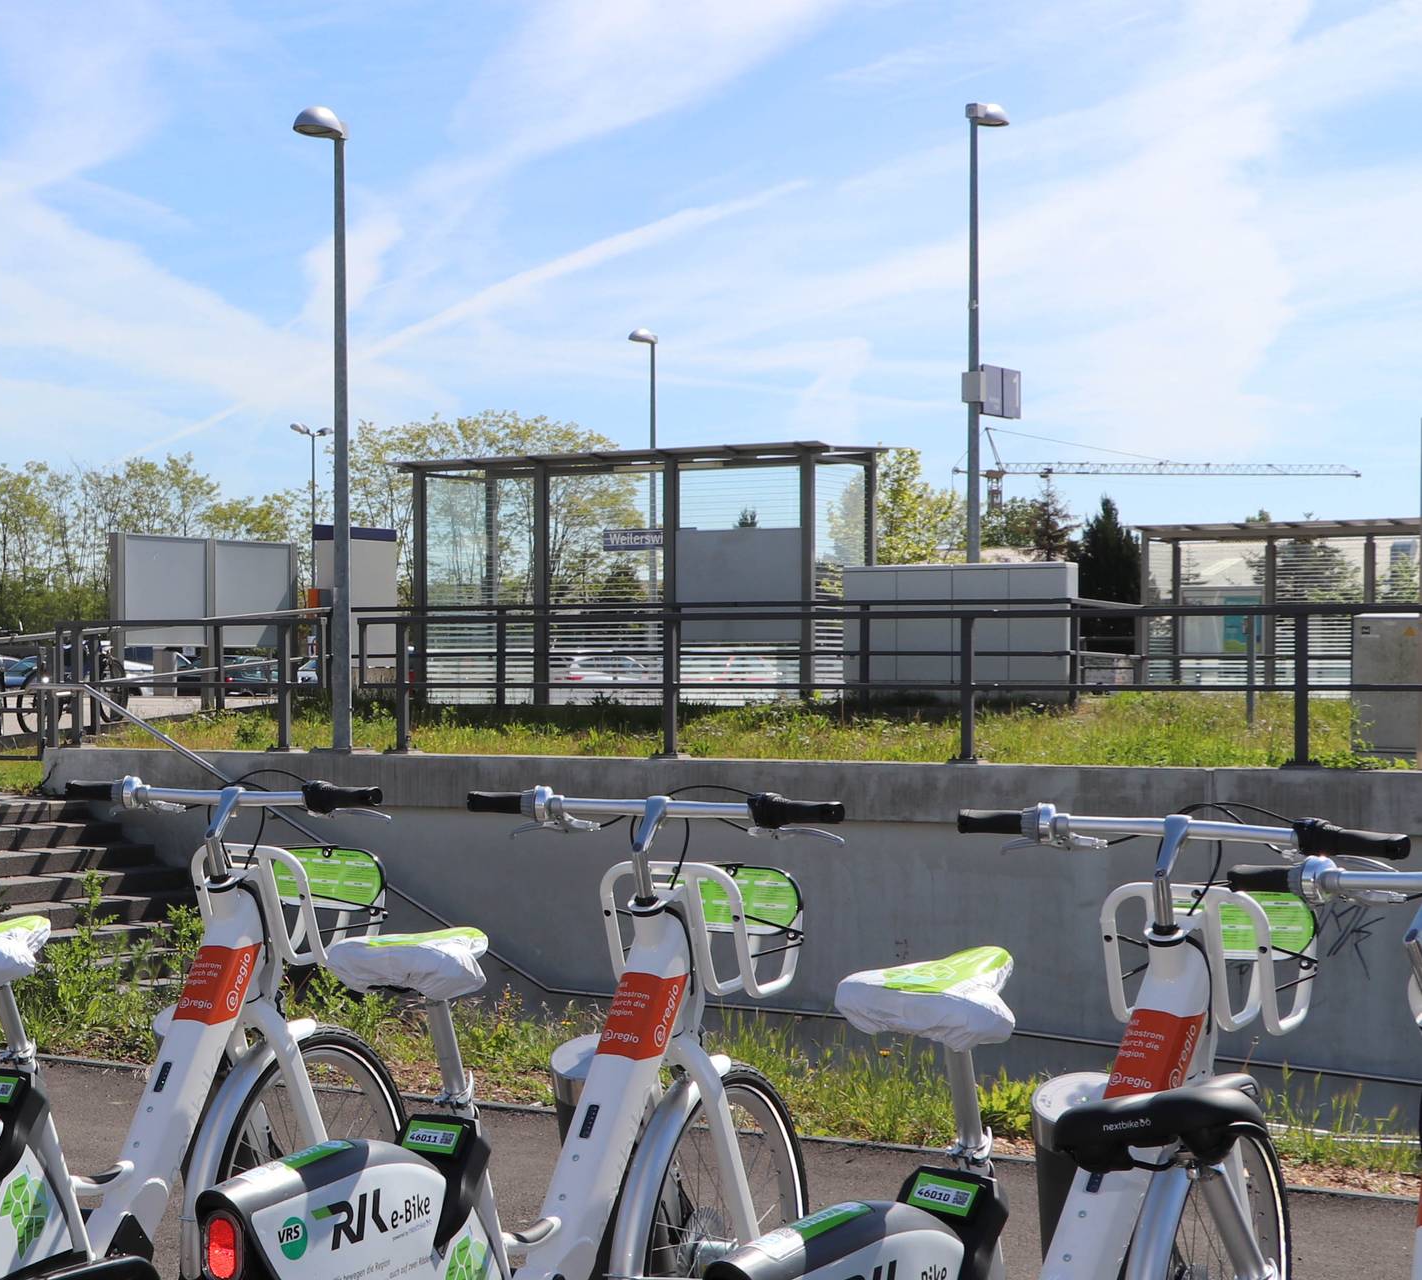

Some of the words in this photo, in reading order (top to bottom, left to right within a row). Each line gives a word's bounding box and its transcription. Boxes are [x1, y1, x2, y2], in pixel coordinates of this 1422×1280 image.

[609, 532, 664, 545] Weilerswi
[633, 1001, 646, 1009] die
[1145, 1042, 1160, 1051] die
[410, 1133, 438, 1143] 46011
[917, 1187, 951, 1202] 46010
[391, 1193, 431, 1230] e-Bike
[277, 1224, 300, 1244] VRS
[366, 1264, 374, 1274] die
[375, 1258, 391, 1271] Region
[389, 1269, 401, 1280] auch
